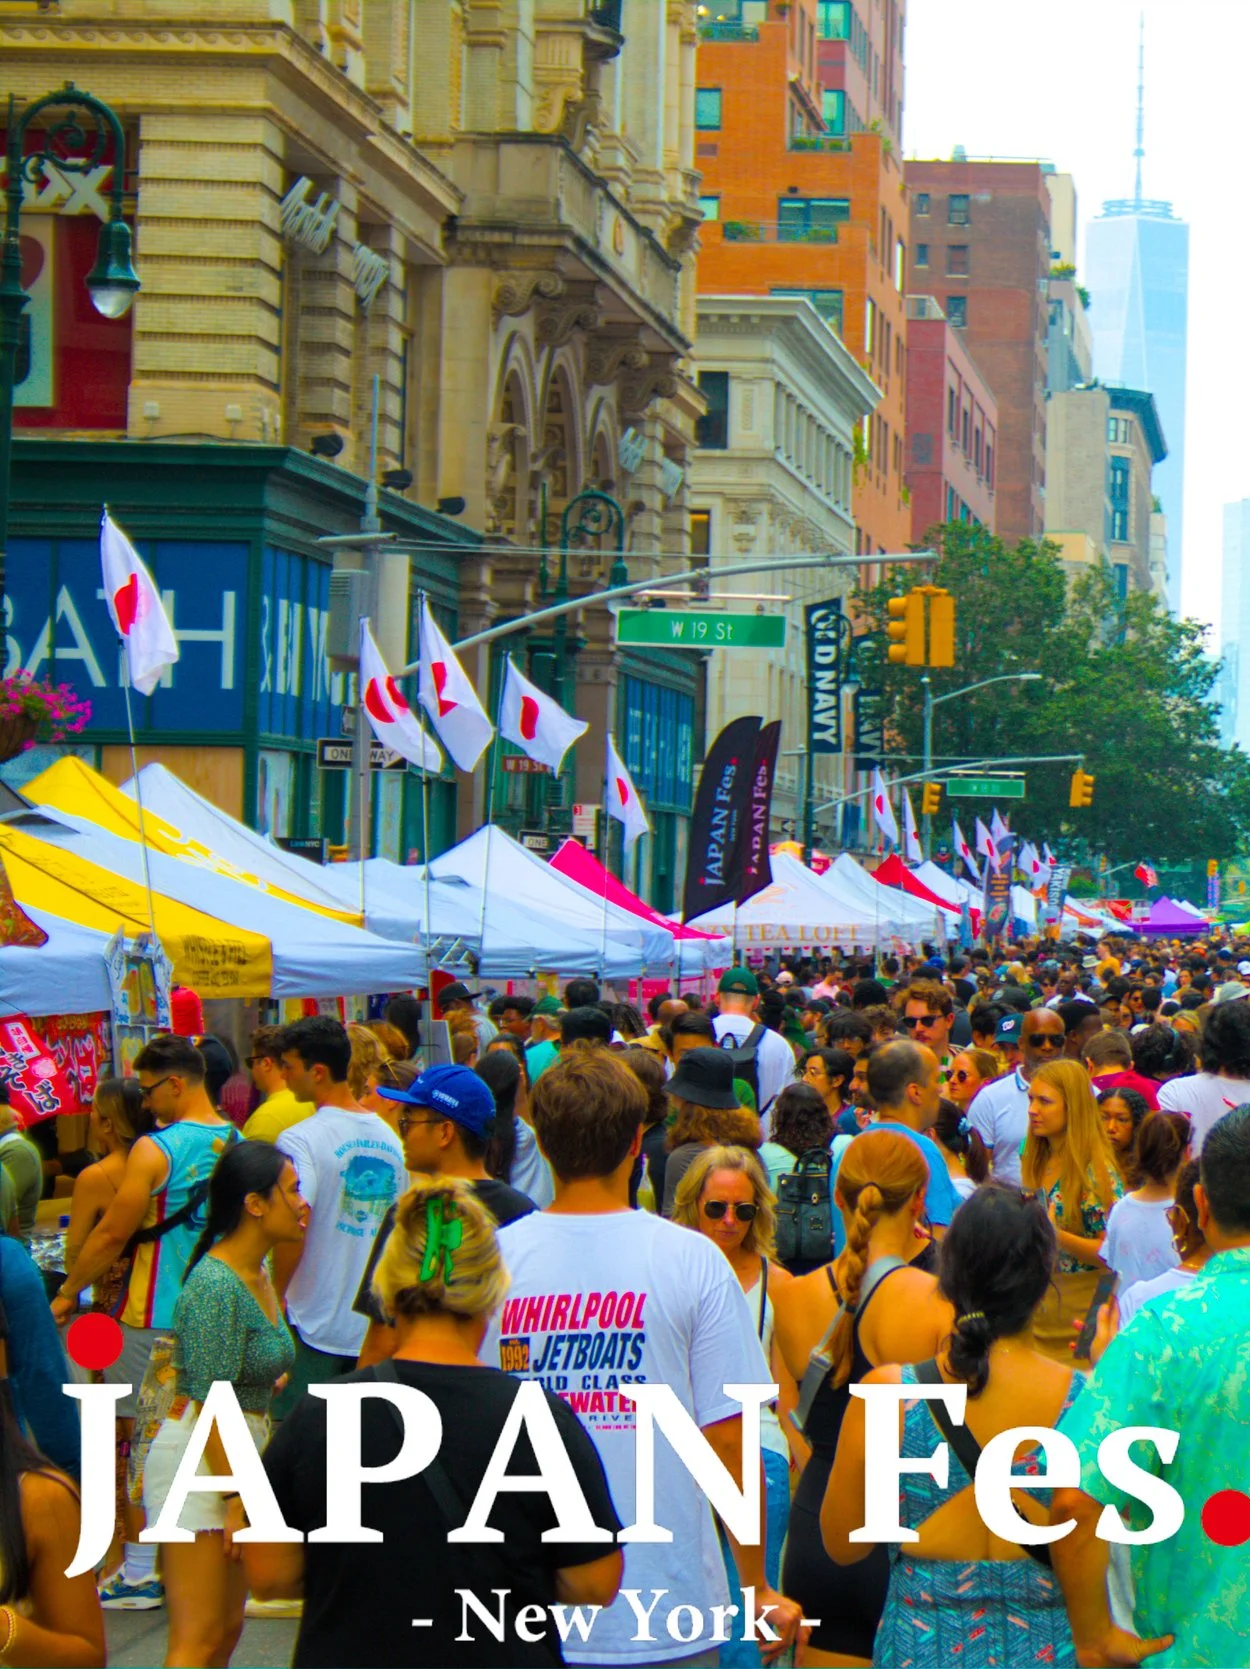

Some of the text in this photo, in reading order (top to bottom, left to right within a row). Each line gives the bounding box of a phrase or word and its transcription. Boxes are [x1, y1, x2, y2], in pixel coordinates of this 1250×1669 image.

[2, 583, 236, 690] AH
[671, 621, 733, 640] W 19 St
[812, 671, 838, 745] NAVY
[703, 807, 728, 885] JAPAN
[744, 924, 792, 942] TEA
[799, 924, 862, 942] LOFT
[500, 1291, 646, 1336] WHIRLPOOL
[501, 1331, 645, 1373] 1992 JETBOATS
